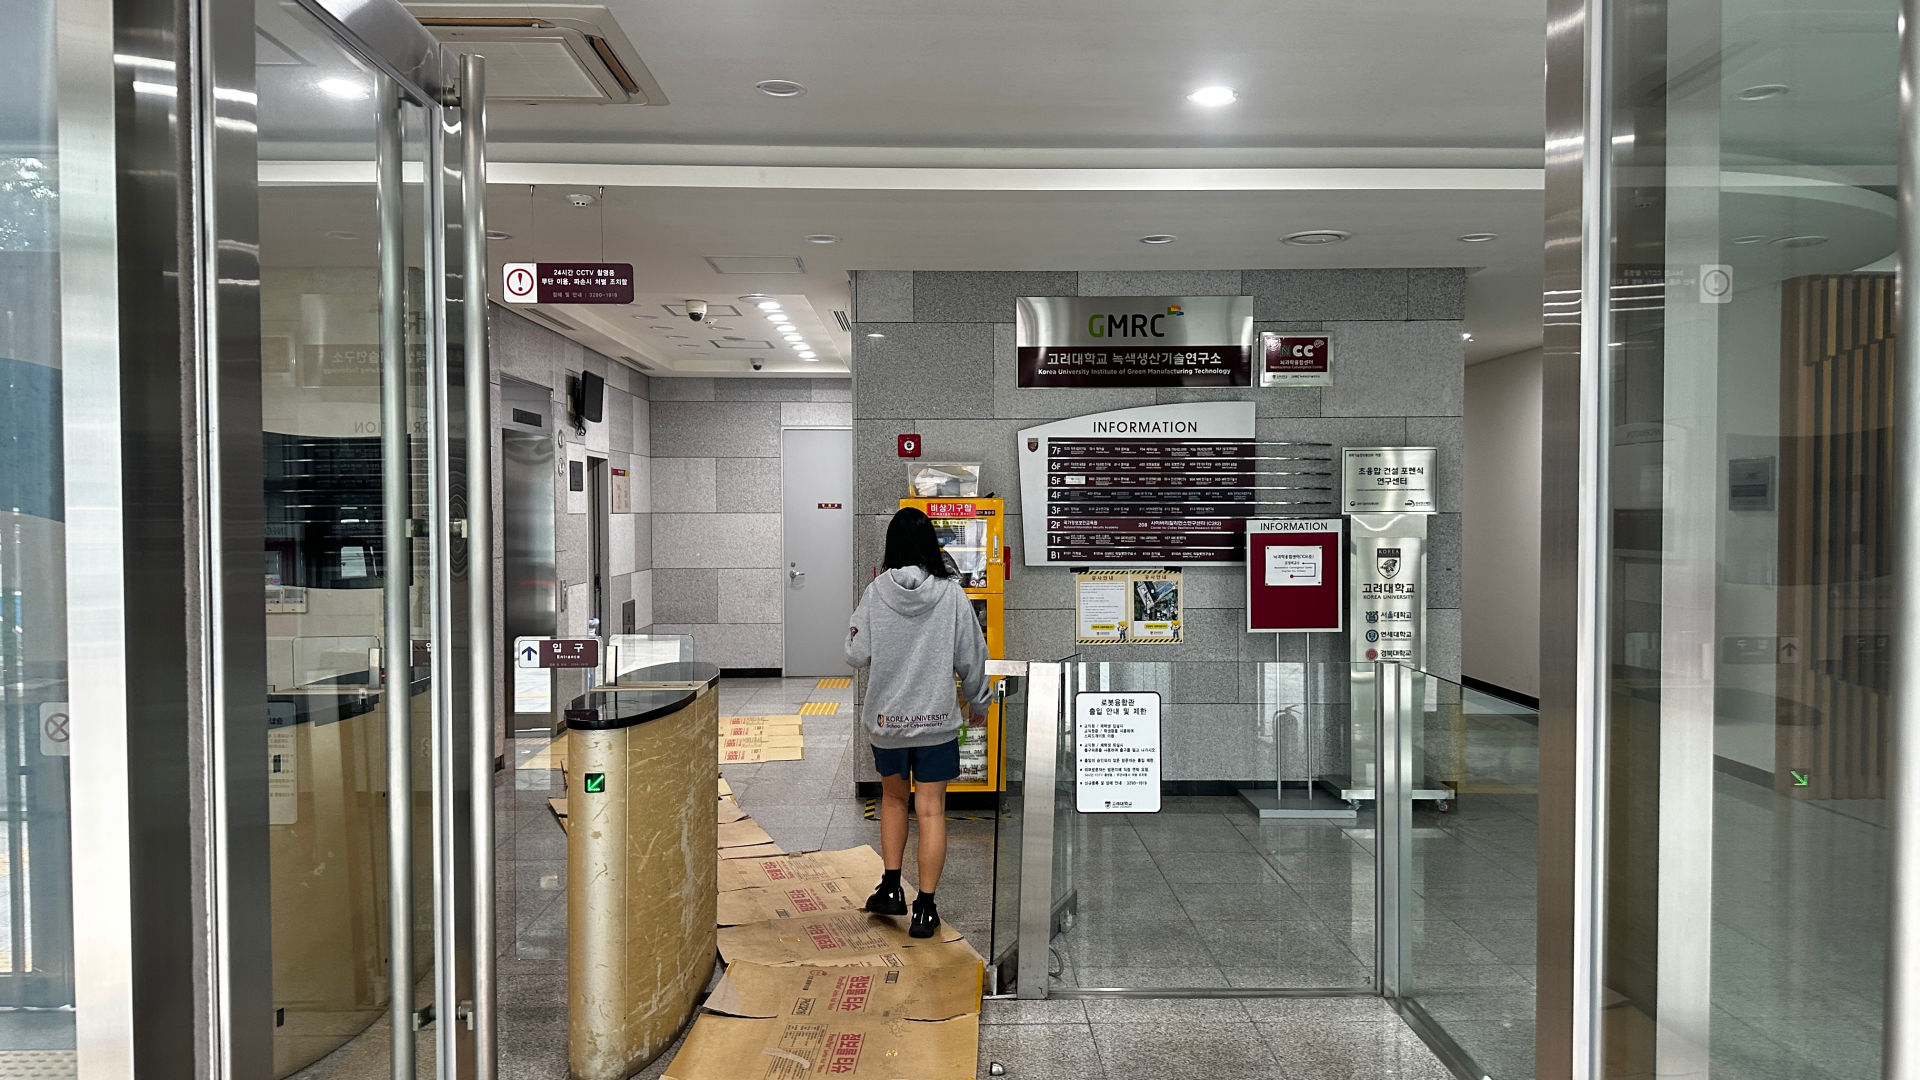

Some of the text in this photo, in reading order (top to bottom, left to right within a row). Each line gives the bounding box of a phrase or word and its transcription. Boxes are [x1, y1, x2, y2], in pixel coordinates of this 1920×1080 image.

[553, 269, 574, 277] 24시간
[1088, 313, 1165, 338] GMRC
[1047, 352, 1222, 366] 고려대학교 녹색생산기술연구소
[1058, 368, 1090, 376] University
[1148, 368, 1193, 376] Manufacturing
[1194, 368, 1231, 376] Technology
[1093, 421, 1197, 433] INFORMATION
[1051, 446, 1061, 455] 7F
[1051, 462, 1061, 470] 6F
[1384, 467, 1399, 475] 건설
[1401, 467, 1424, 475] 포렌식
[1051, 476, 1061, 485] 5F
[1377, 477, 1407, 485] 연구센터
[1051, 491, 1061, 499] 4F
[930, 503, 972, 512] 비상기구함
[1051, 505, 1061, 514] 3F
[1051, 520, 1061, 529] 2F
[1260, 522, 1328, 531] INFORMATION
[1052, 535, 1061, 543] 1F
[1051, 551, 1061, 559] B1
[1362, 583, 1415, 593] 고려대학교
[1380, 611, 1412, 619] 서울대학교
[886, 713, 949, 722] KOREA UNIVERSITY
[841, 996, 864, 1012] 티슈
[835, 1033, 861, 1056] 점보롤
[831, 1057, 854, 1074] 티슈
